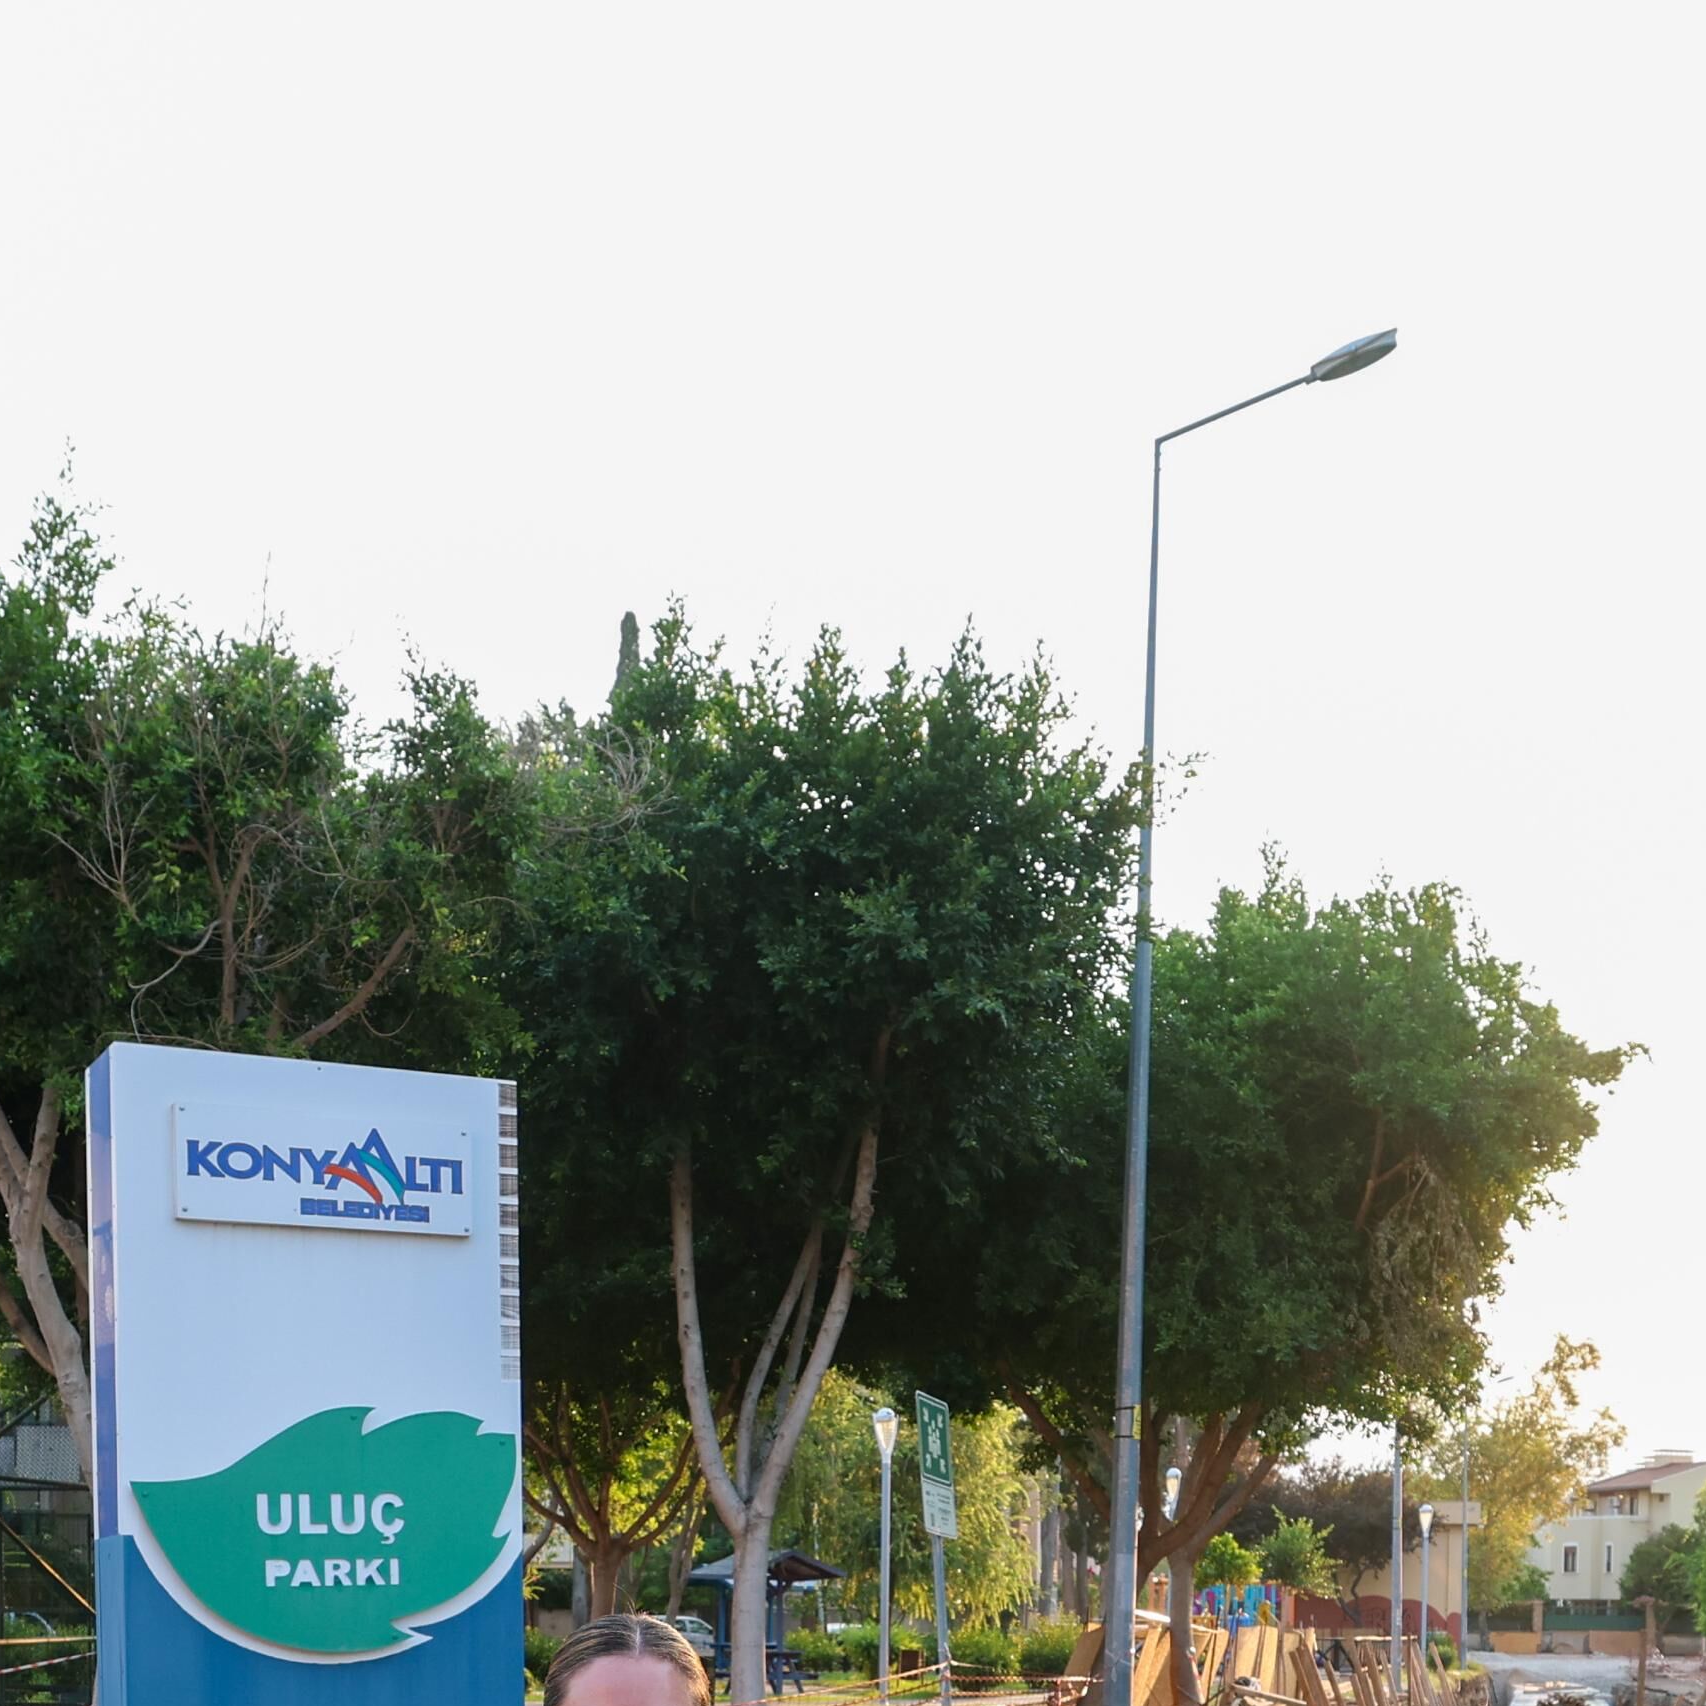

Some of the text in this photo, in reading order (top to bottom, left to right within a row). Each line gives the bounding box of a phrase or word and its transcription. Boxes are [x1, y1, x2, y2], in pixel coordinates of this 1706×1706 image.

[186, 1128, 464, 1196] KONYAALTI
[256, 1493, 405, 1545] ULUÇ
[265, 1557, 400, 1588] PARKI
